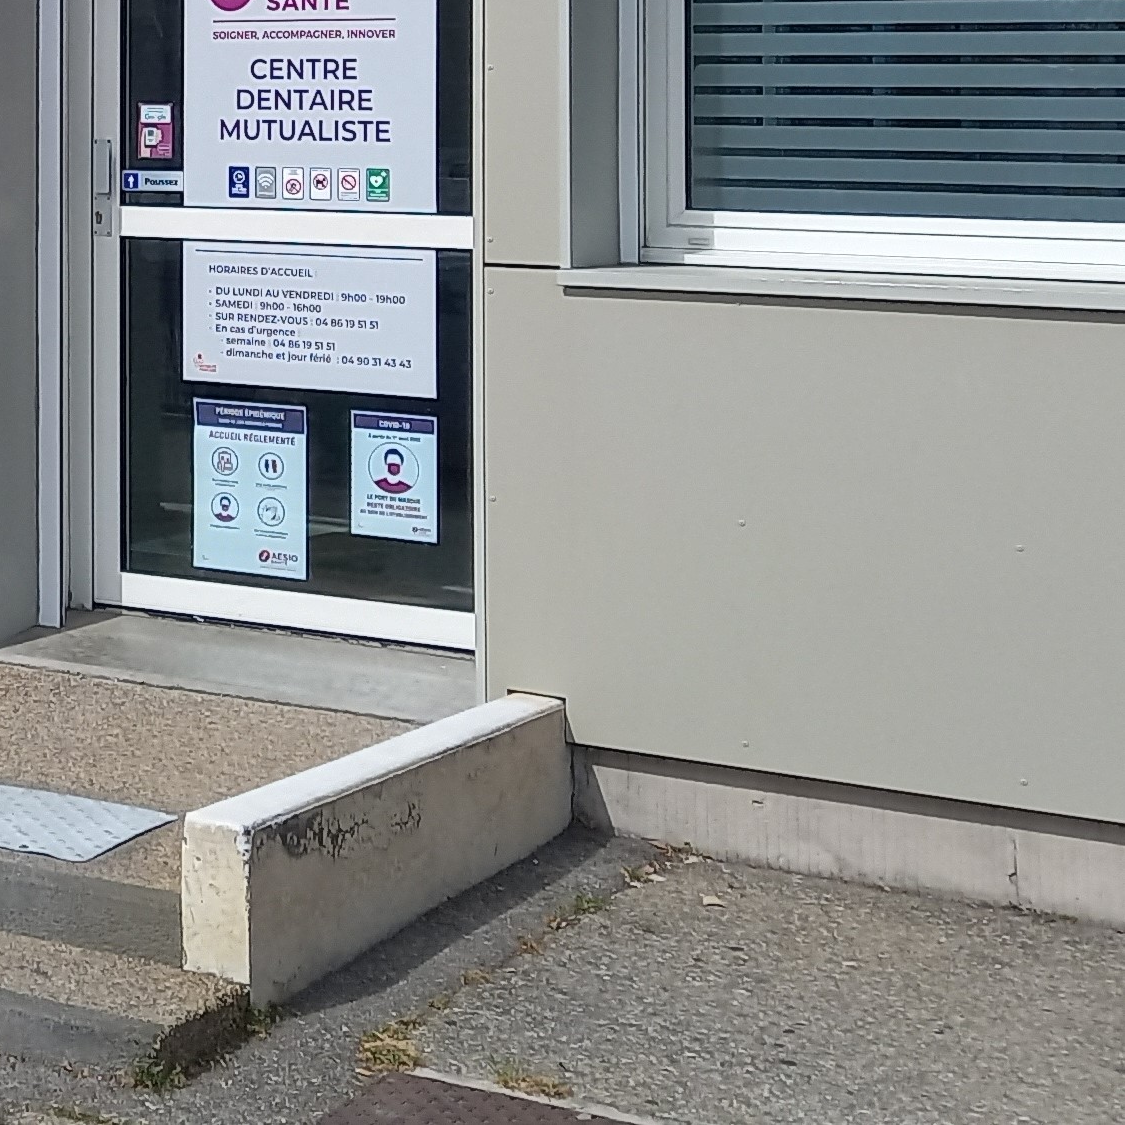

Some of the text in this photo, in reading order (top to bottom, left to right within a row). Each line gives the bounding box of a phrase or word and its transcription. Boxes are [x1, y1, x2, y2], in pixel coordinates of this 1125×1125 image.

[212, 29, 396, 40] SOIGNER, ACCOMPAGNER, INNOVER
[250, 58, 358, 81] CENTRE
[236, 89, 374, 111] DENTAIRE
[219, 120, 392, 143] MUTUALISTE
[208, 264, 314, 278] HORAIRES D'ACCUEIL
[215, 286, 230, 296] DU
[232, 287, 263, 297] LUNDI
[265, 288, 280, 298] AU
[282, 289, 334, 301] VENDREDI
[341, 293, 367, 303] 9h00
[376, 294, 406, 304] 19h00
[215, 299, 253, 309] SAMEDI
[259, 301, 285, 311] 9h00
[293, 303, 322, 313] 16h00
[215, 312, 235, 321] SUR
[237, 313, 309, 326] RENDEZ-VOUS
[315, 317, 328, 327] 04
[331, 318, 343, 327] 86
[345, 319, 355, 328] 19
[357, 320, 367, 329] 51
[369, 320, 379, 329] 51
[215, 324, 296, 337] En cas d'urgence
[226, 337, 335, 351] semaine 04 86 19 51 51
[226, 348, 274, 360] dimanche
[275, 351, 286, 361] et
[287, 351, 308, 362] jour
[341, 355, 355, 365] 04
[356, 356, 370, 366] 90
[371, 357, 382, 367] 31
[384, 358, 396, 368] 43
[398, 359, 412, 369] 43
[208, 430, 241, 442] ACCUEIL
